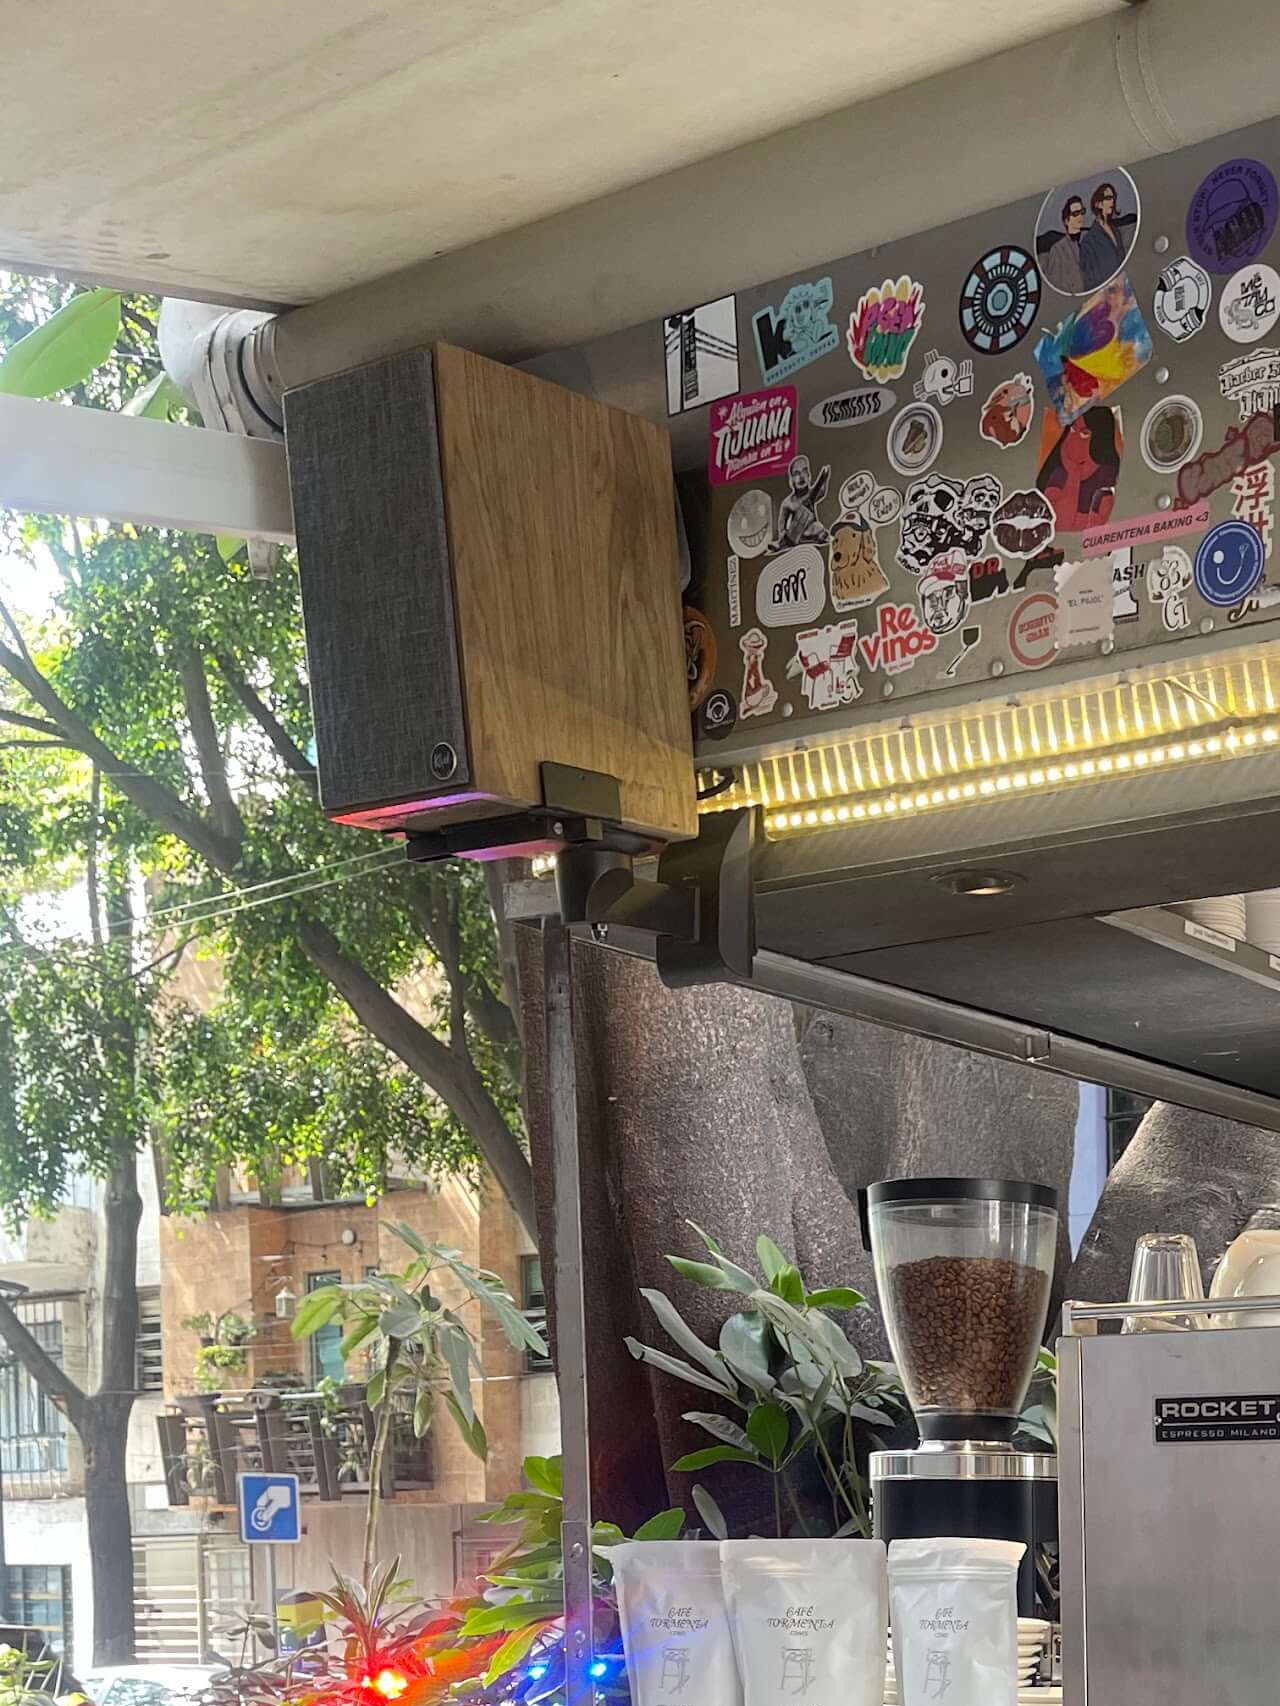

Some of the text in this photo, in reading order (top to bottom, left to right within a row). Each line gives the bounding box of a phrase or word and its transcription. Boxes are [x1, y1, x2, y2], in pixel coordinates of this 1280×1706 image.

[713, 407, 792, 469] TIJUANA
[1082, 526, 1150, 549] CUARENTENA
[1152, 516, 1193, 535] BAKING
[879, 606, 917, 638] Re
[862, 627, 937, 668] Vinos
[1161, 1399, 1277, 1419] ROCKET
[1161, 1426, 1277, 1440] ESPRESSO MILANO
